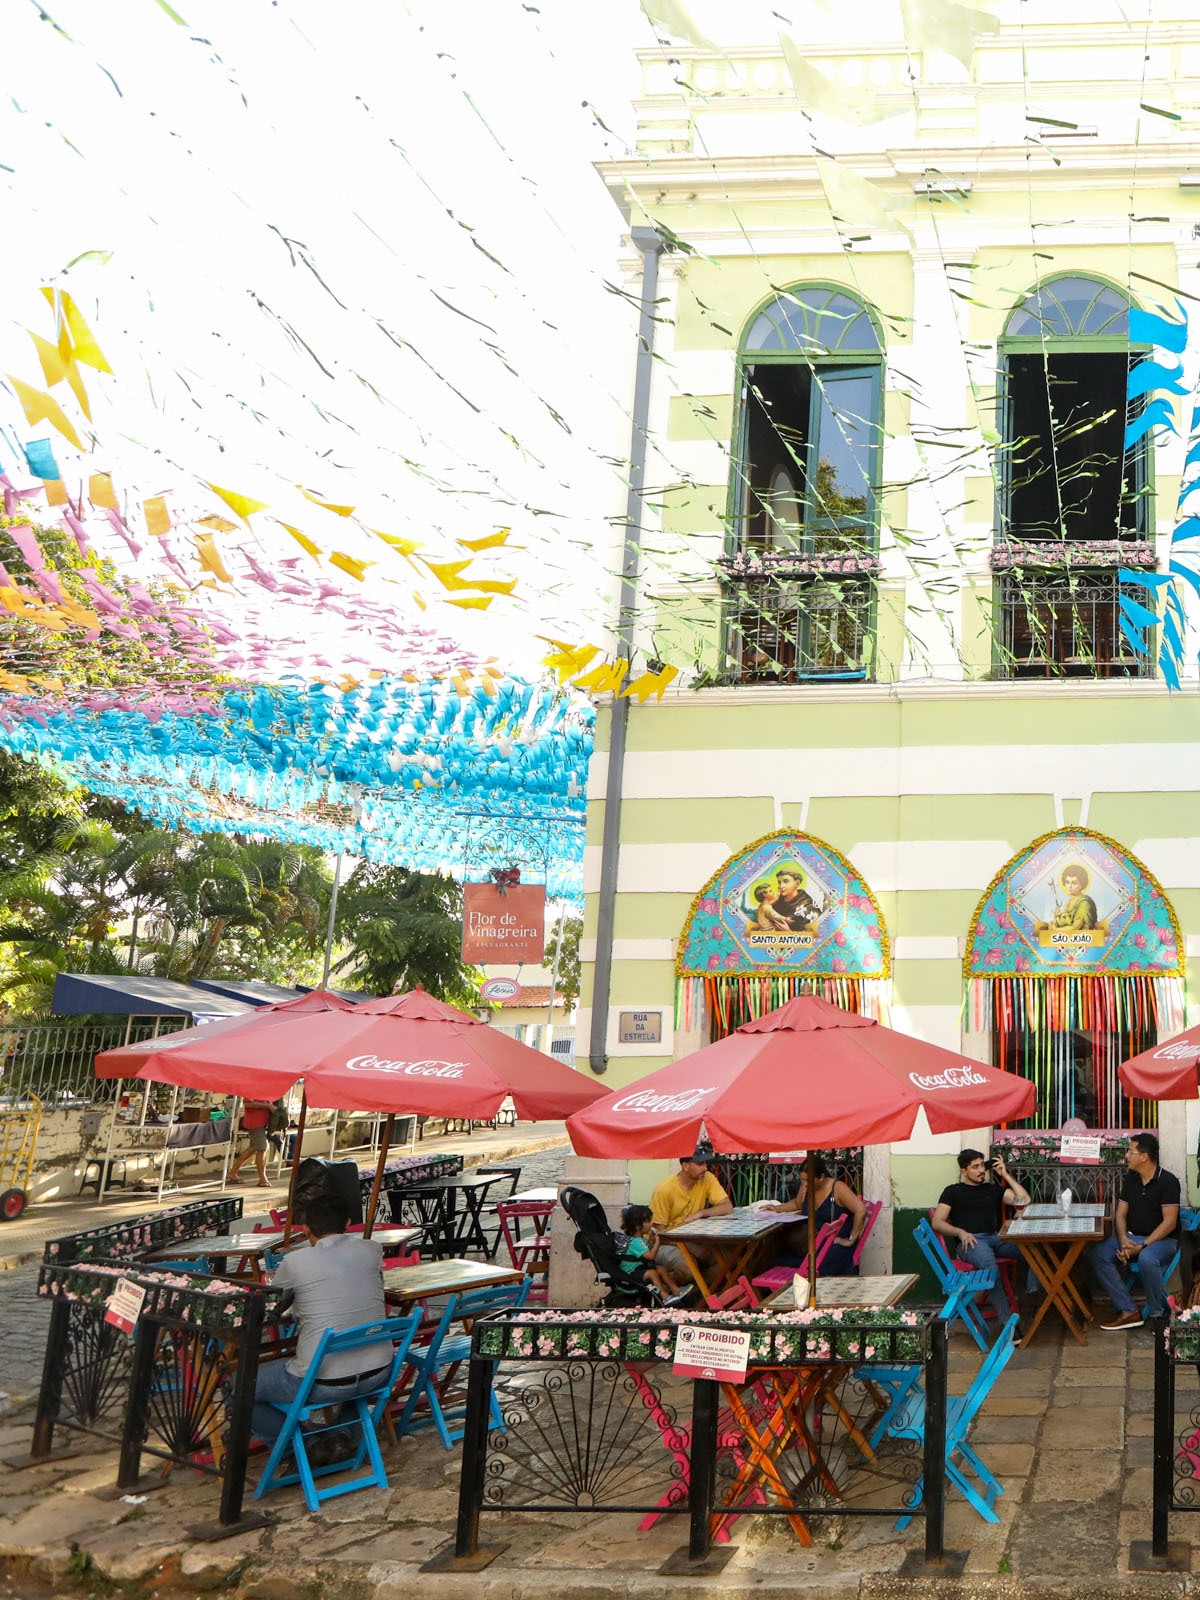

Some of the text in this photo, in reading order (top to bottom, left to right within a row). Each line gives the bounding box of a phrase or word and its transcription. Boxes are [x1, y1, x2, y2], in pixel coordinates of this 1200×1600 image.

[469, 912, 516, 924] Flor de
[469, 924, 537, 938] Vinagreira
[752, 936, 776, 944] SANTO
[1052, 934, 1092, 942] SÃO JOÃO
[346, 1054, 471, 1078] Coca-Cola
[909, 1065, 987, 1090] Coca-Cola
[698, 1332, 744, 1345] PROIBIDO
